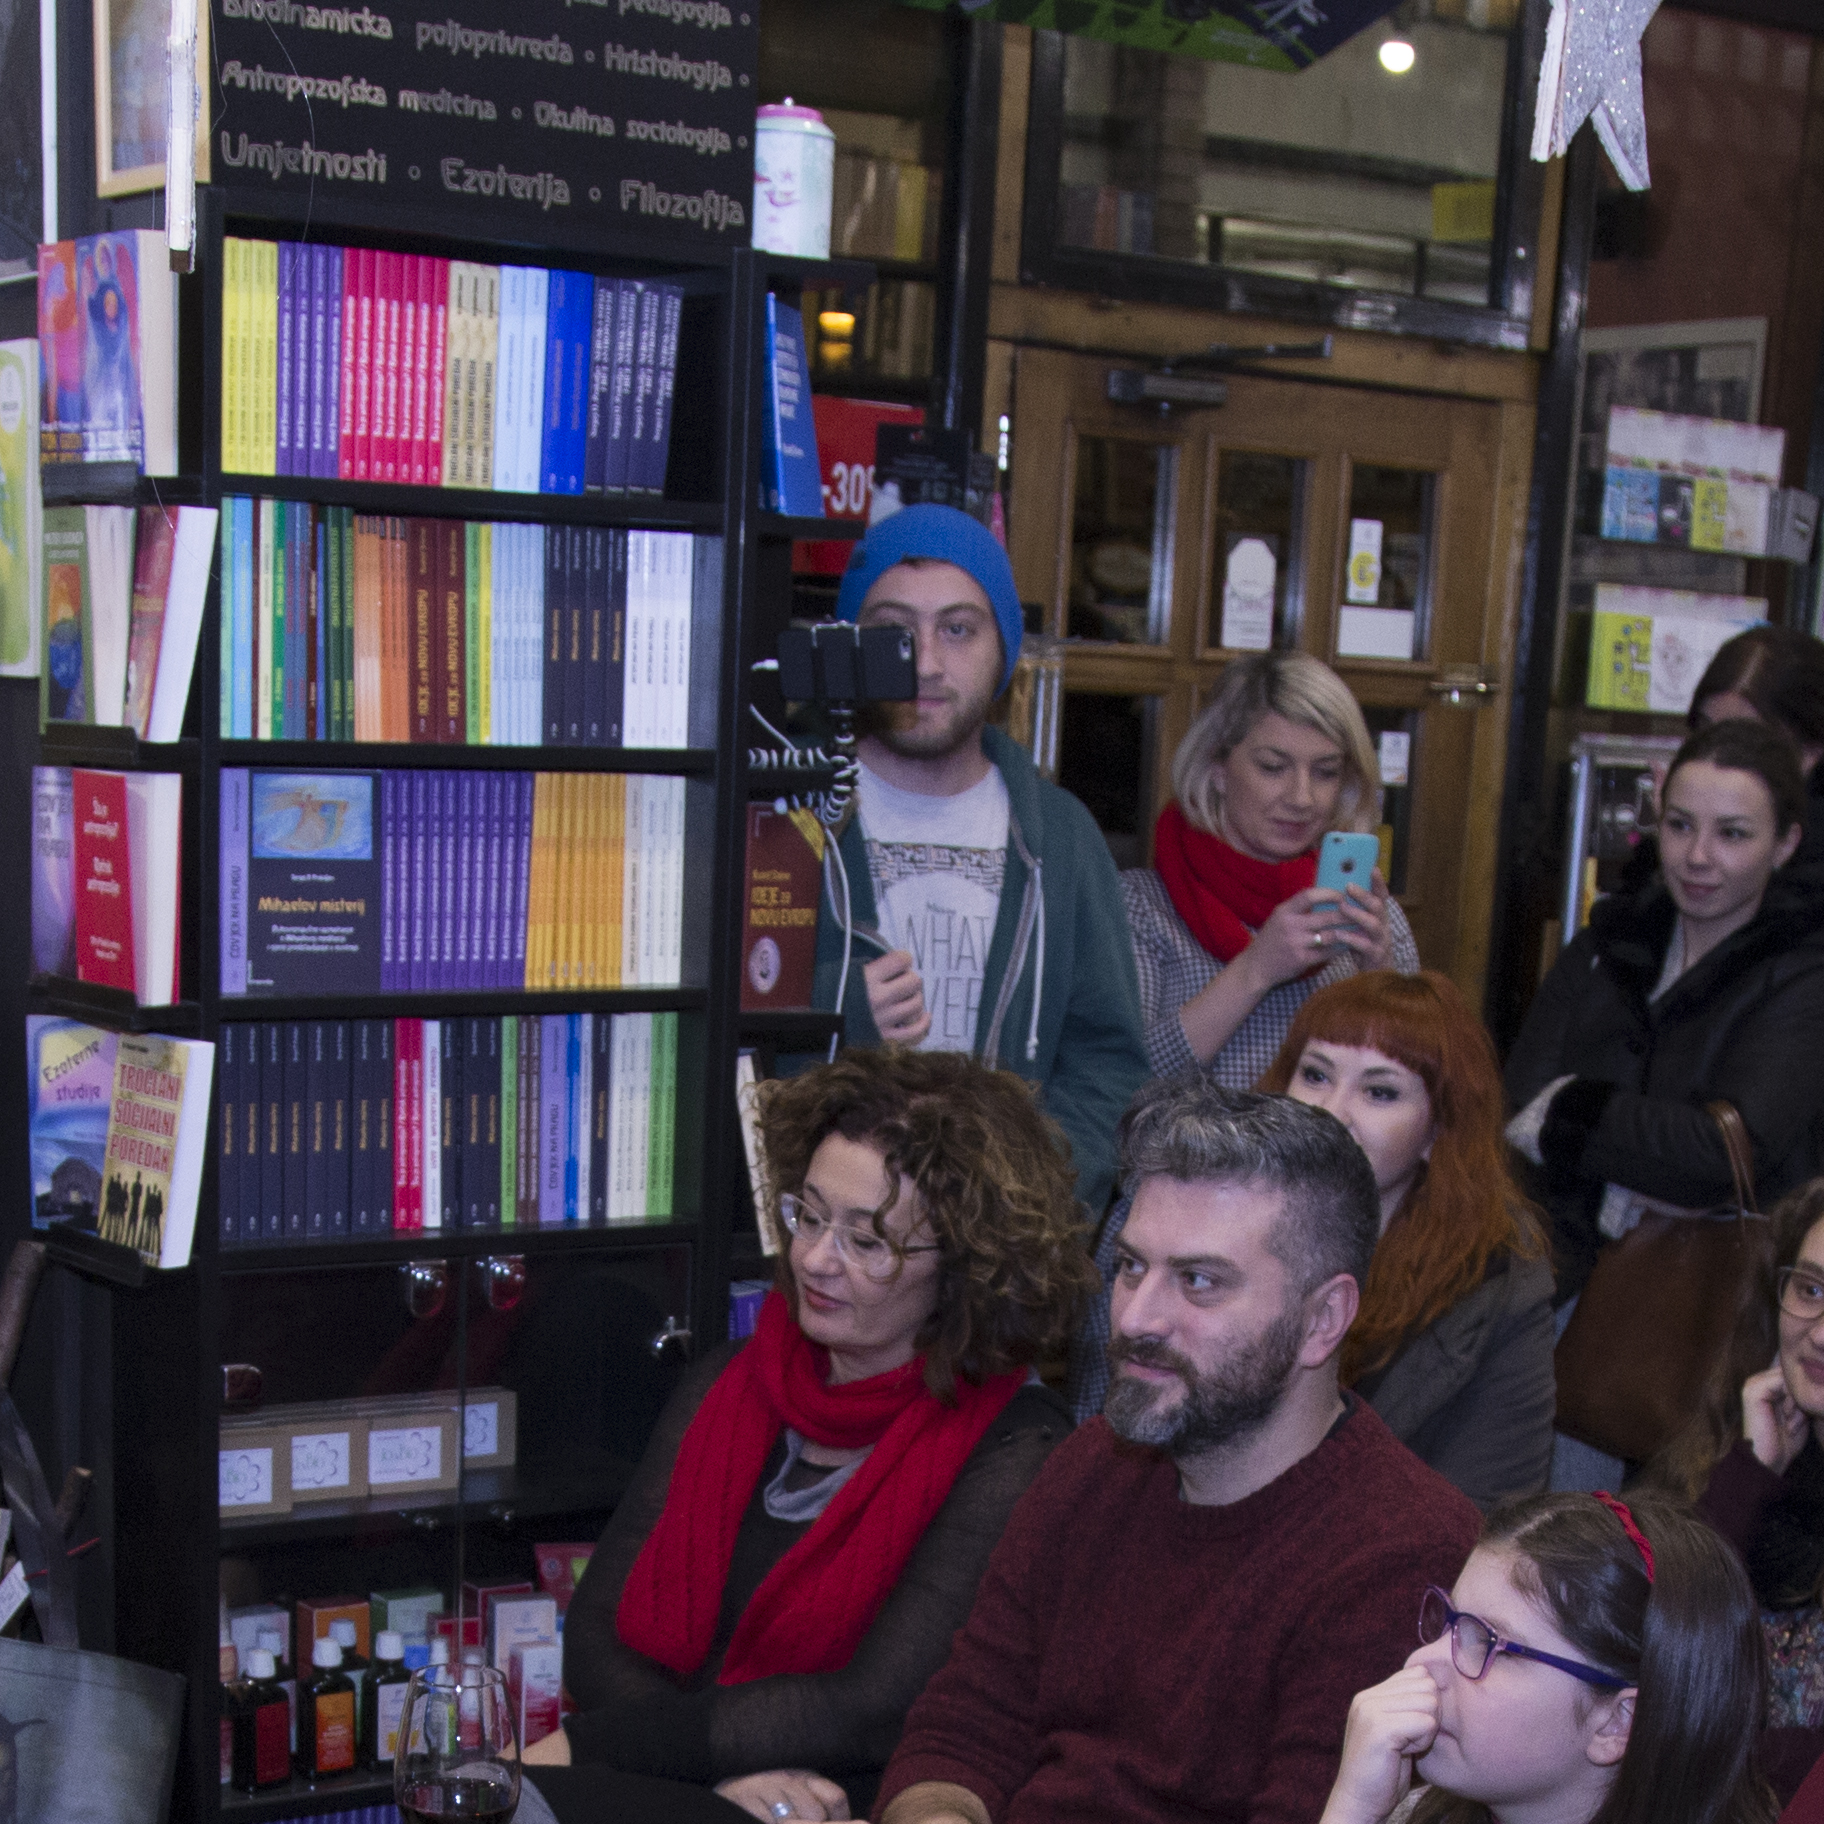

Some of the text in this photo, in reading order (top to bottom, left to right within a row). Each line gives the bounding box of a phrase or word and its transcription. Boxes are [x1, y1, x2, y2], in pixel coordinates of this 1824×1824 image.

[416, 18, 732, 92] poljoprivreda Hristologija
[221, 60, 387, 109] Antropozofska
[398, 88, 497, 121] medicina
[626, 119, 732, 156] sociologija
[221, 131, 744, 231] Umjetnosti Ezoterija Filozofija
